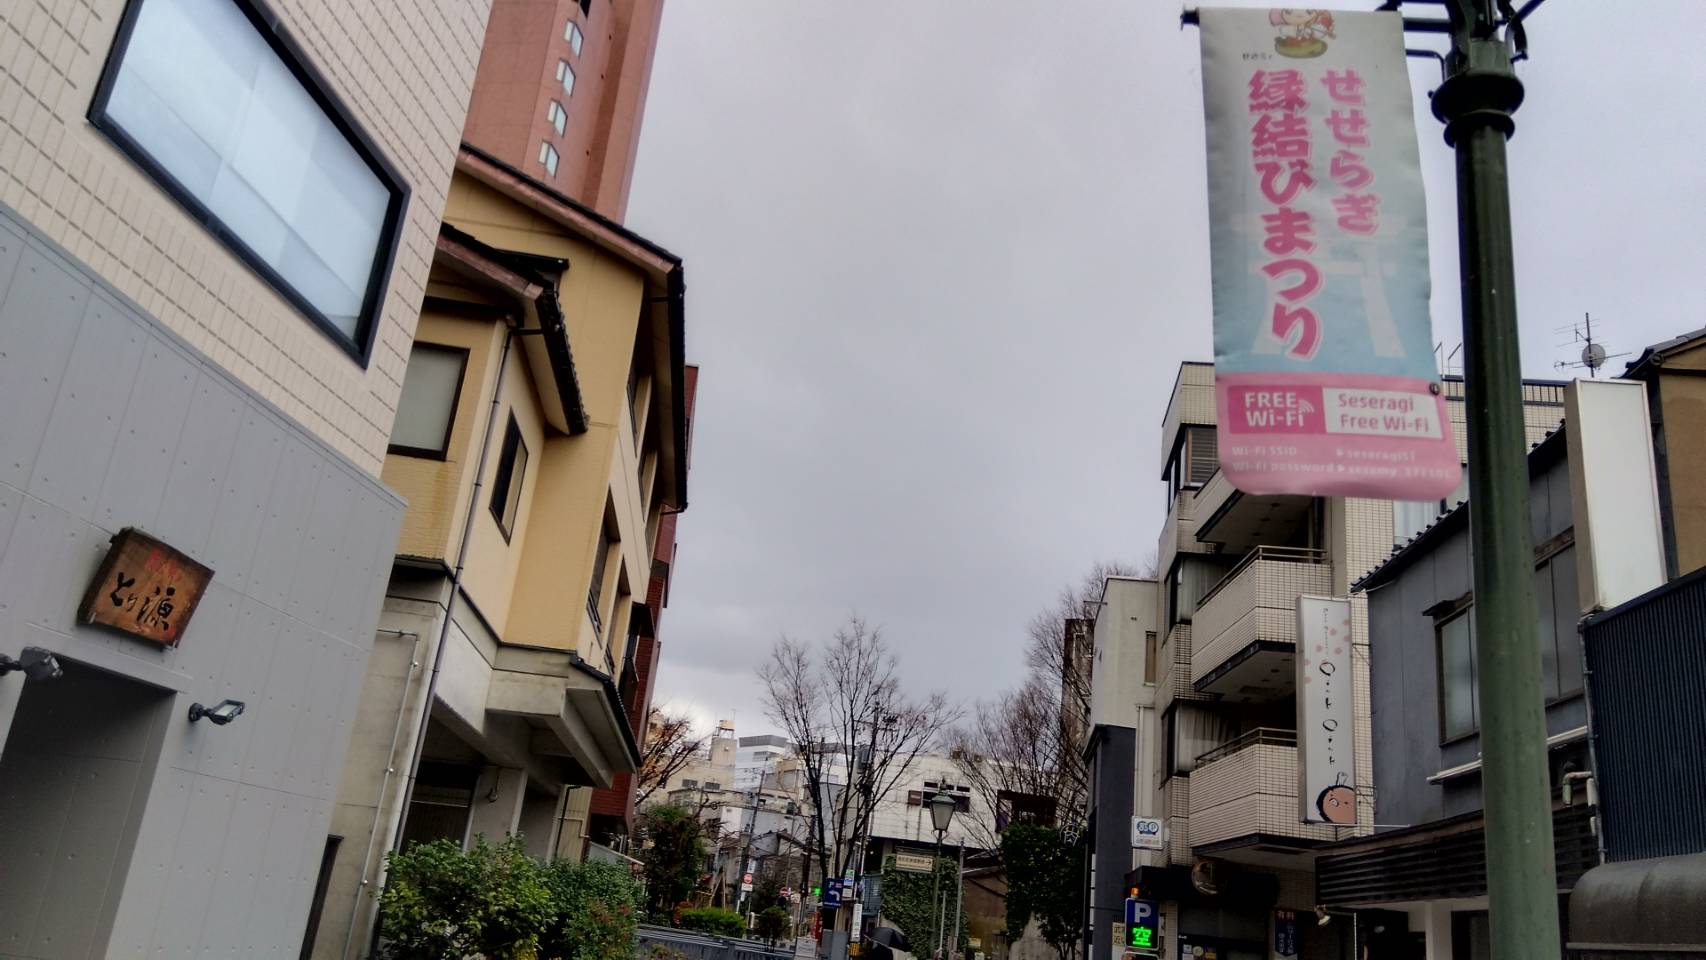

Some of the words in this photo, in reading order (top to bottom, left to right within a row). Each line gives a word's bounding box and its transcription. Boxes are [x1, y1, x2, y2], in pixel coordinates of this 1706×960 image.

[1320, 69, 1381, 236] せせらぎ
[1248, 69, 1323, 360] 縁結びまつり
[1245, 391, 1297, 408] FREE
[1338, 393, 1414, 412] Seseragi
[1246, 409, 1304, 427] Wi-Fi
[1340, 414, 1378, 429] Free
[1383, 415, 1429, 432] Wi-Fi
[1271, 462, 1334, 473] password
[1134, 902, 1151, 923] P
[1132, 926, 1152, 946] 空
